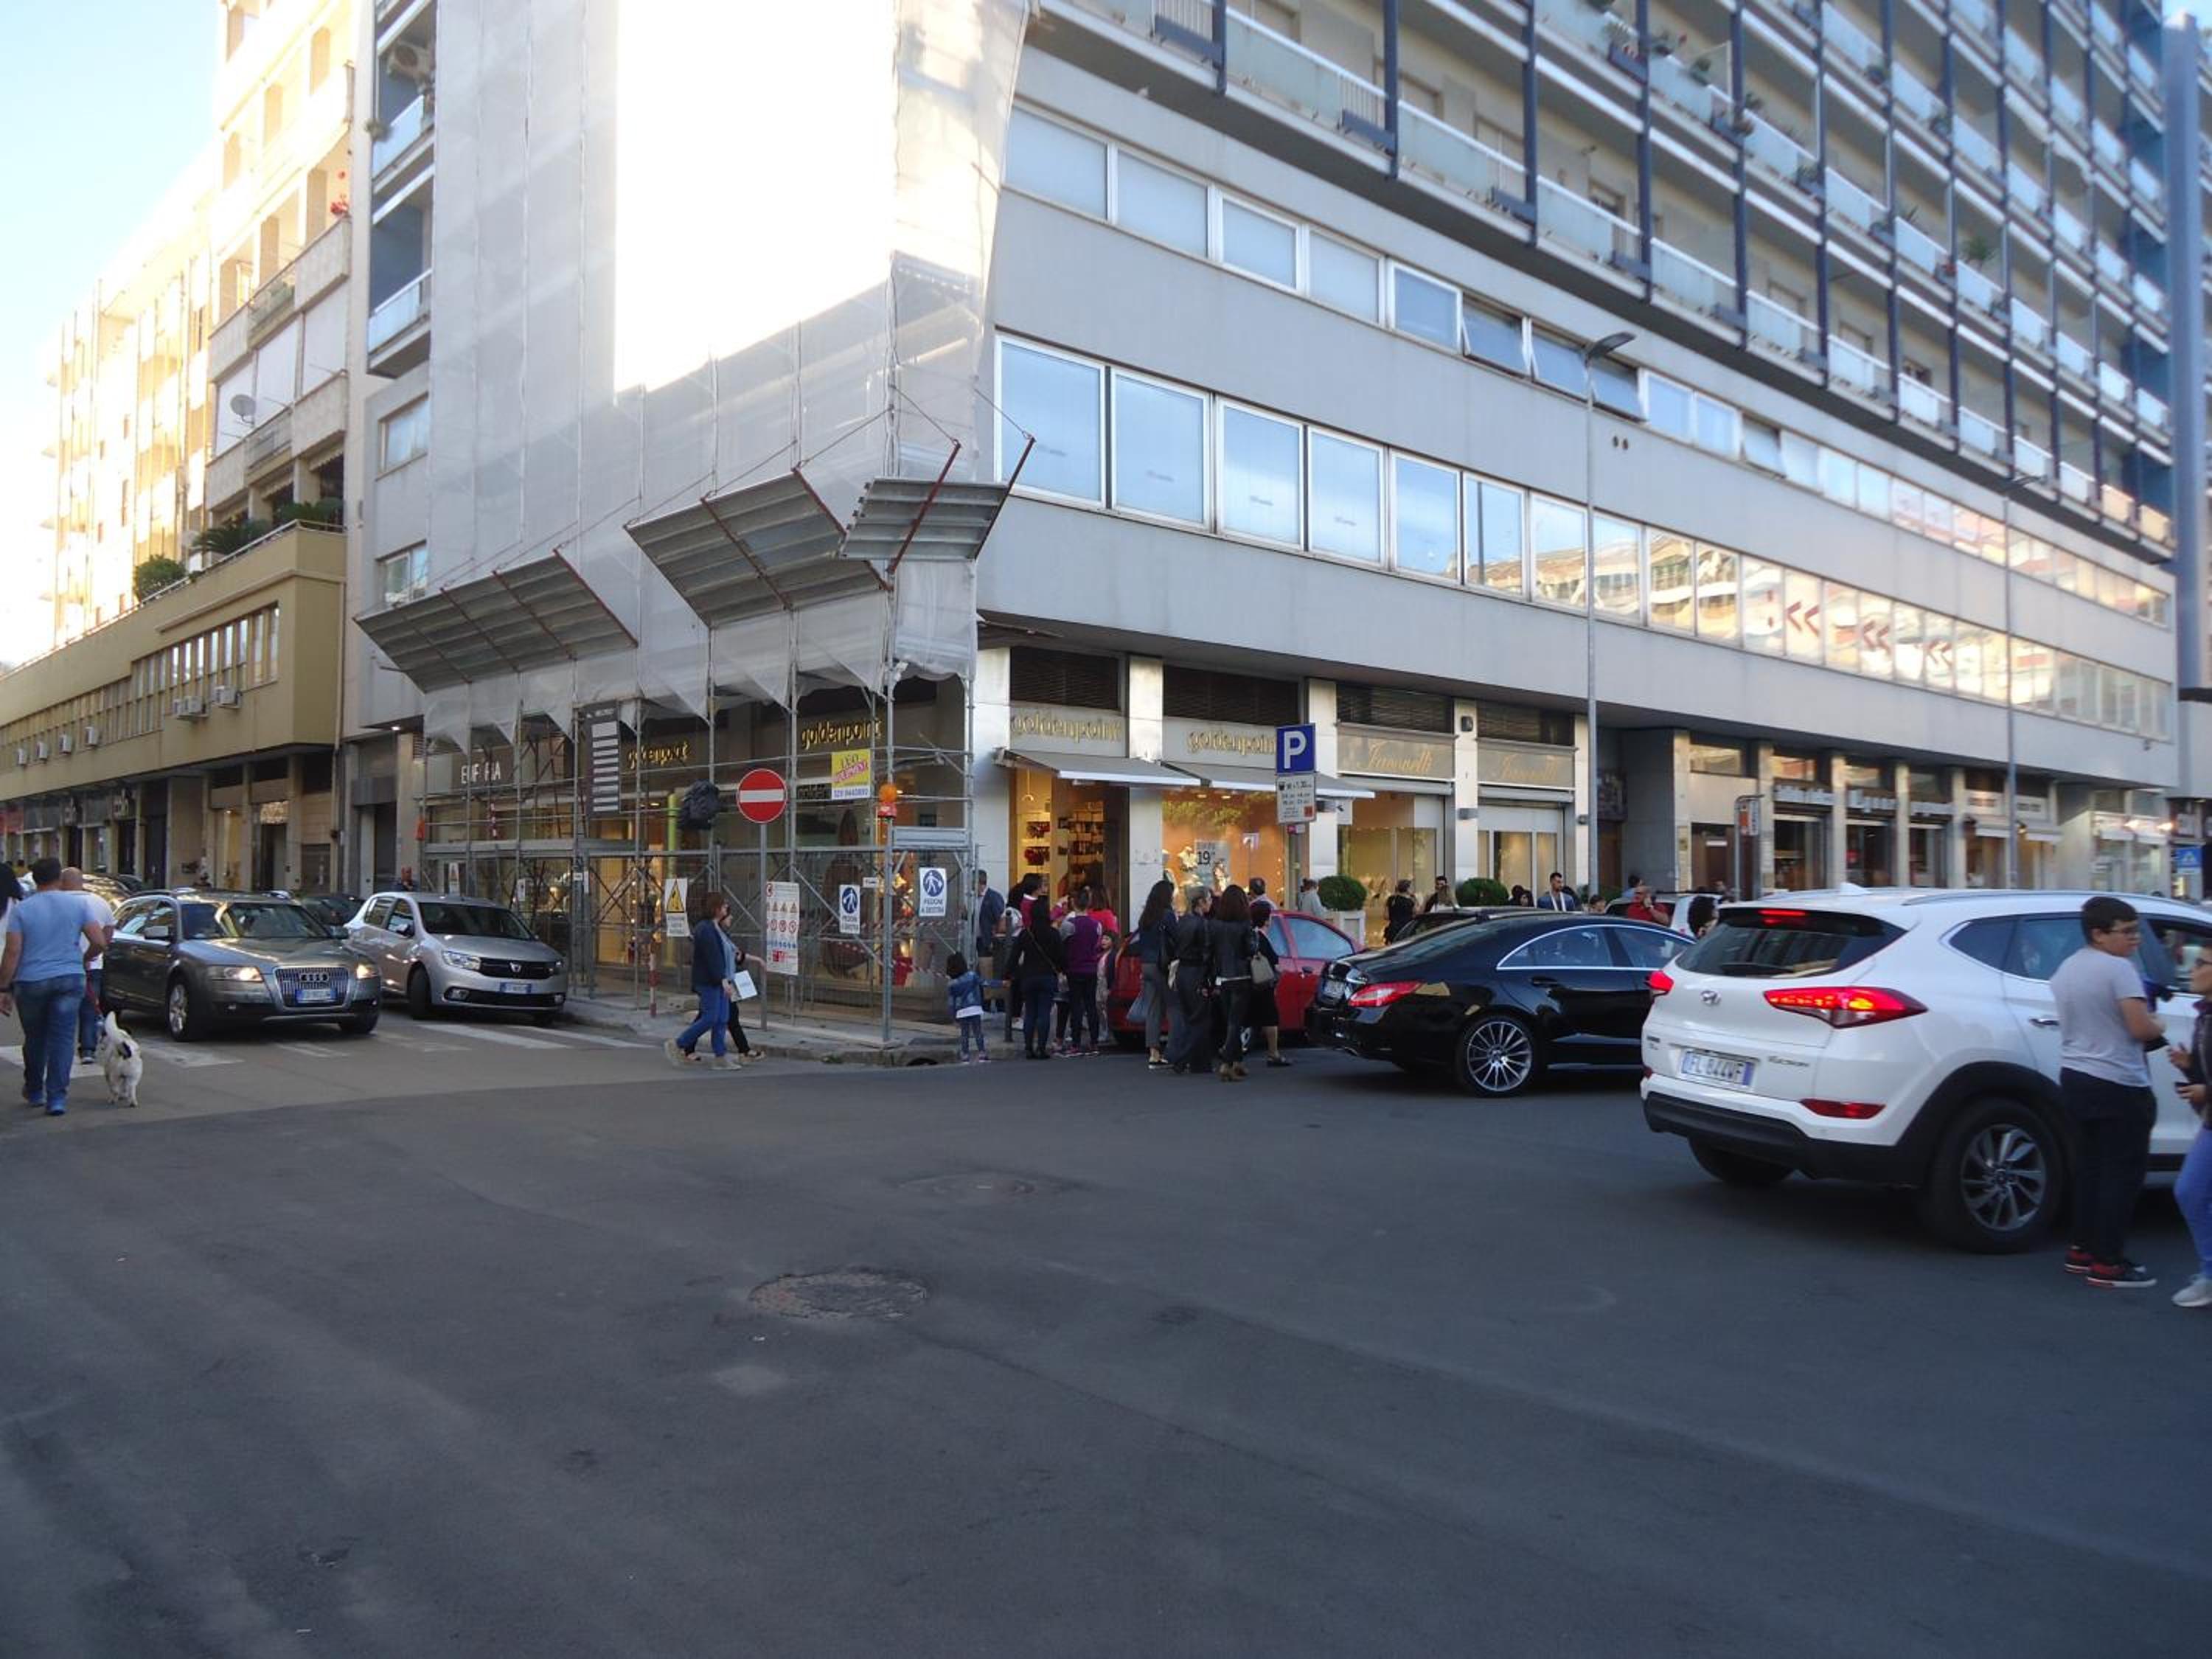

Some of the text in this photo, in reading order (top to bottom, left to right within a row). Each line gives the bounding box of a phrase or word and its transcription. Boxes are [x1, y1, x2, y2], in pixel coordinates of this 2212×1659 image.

[1010, 709, 1121, 744] goldenpoint
[1187, 728, 1277, 756] goldenpoin
[1284, 731, 1307, 769] P
